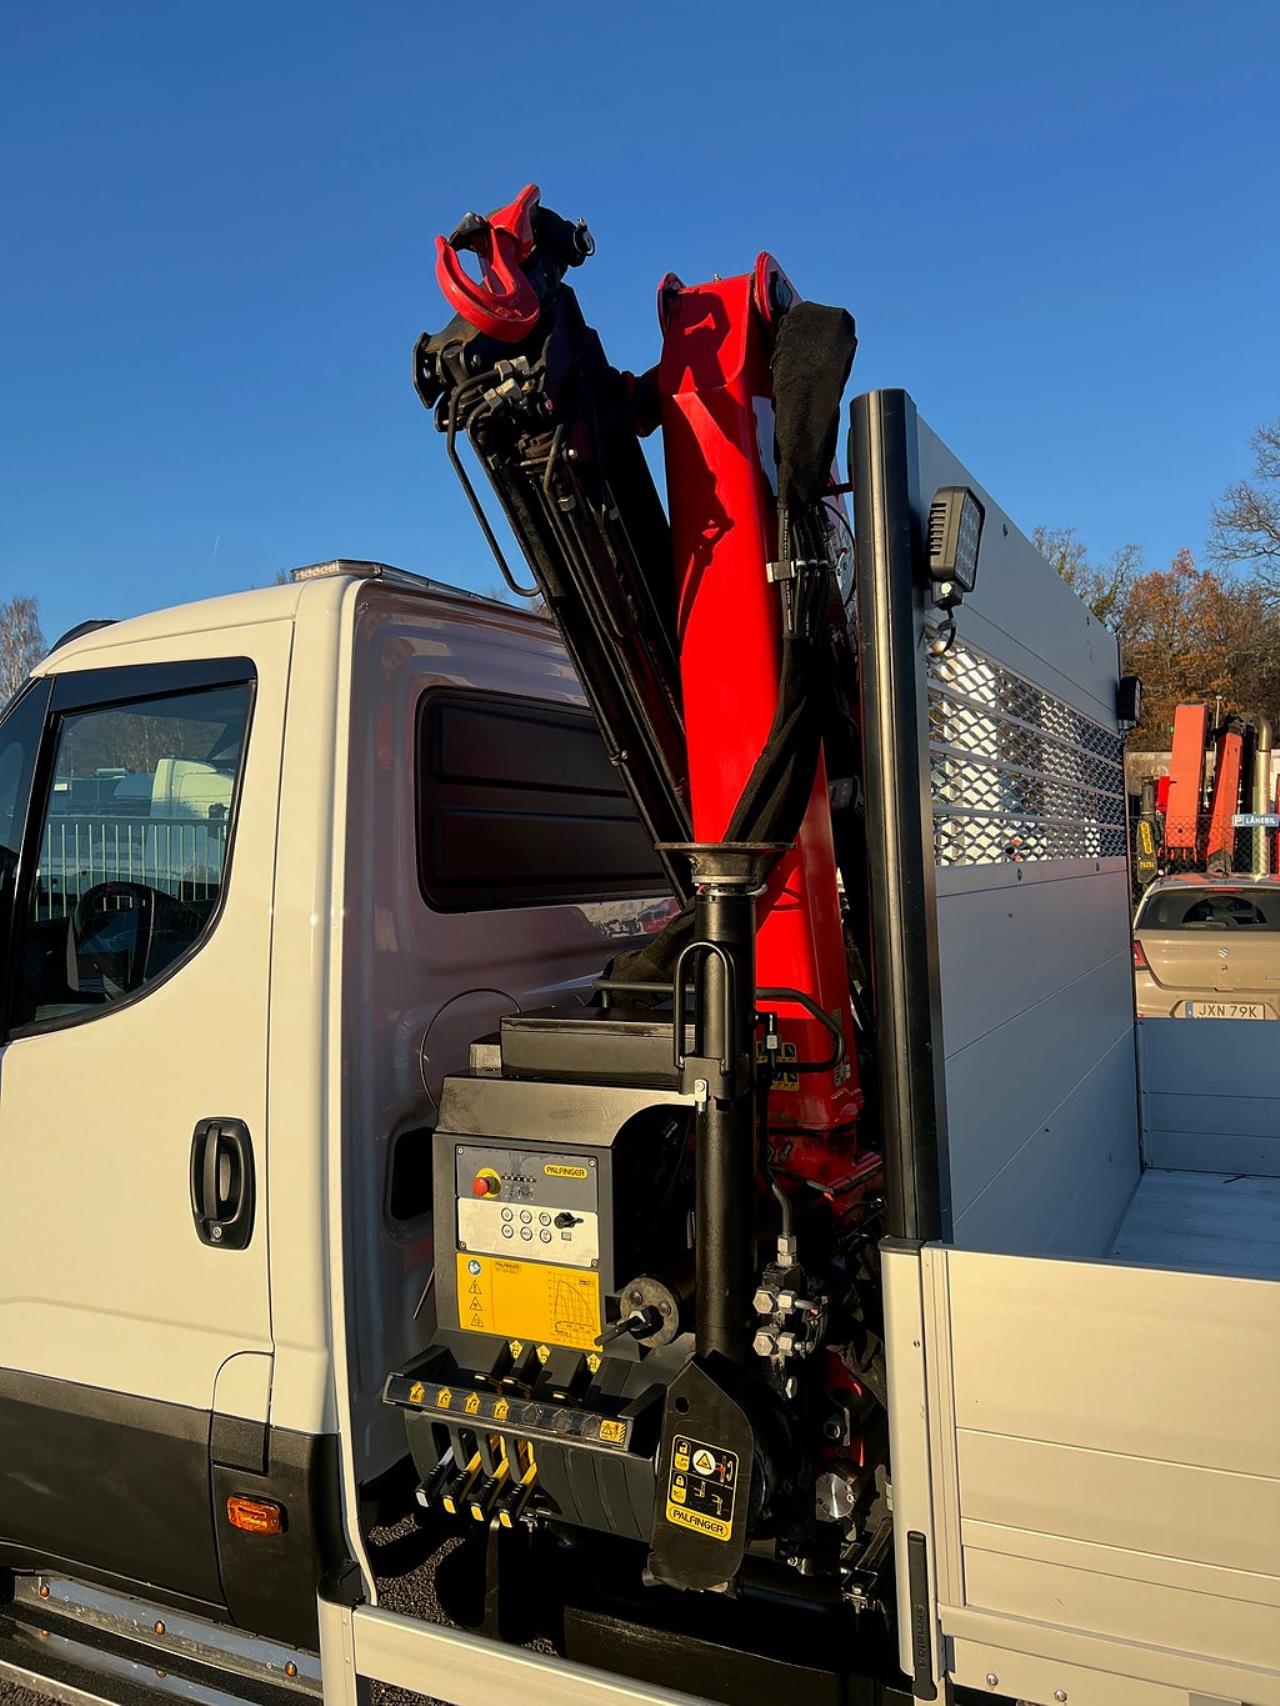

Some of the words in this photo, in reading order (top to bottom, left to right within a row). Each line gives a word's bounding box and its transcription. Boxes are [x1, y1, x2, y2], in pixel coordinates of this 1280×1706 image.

[1199, 1004, 1226, 1017] JXN
[1229, 1005, 1257, 1018] 79K
[546, 1166, 586, 1177] PALFINGER
[673, 1509, 724, 1535] PALFINGER
